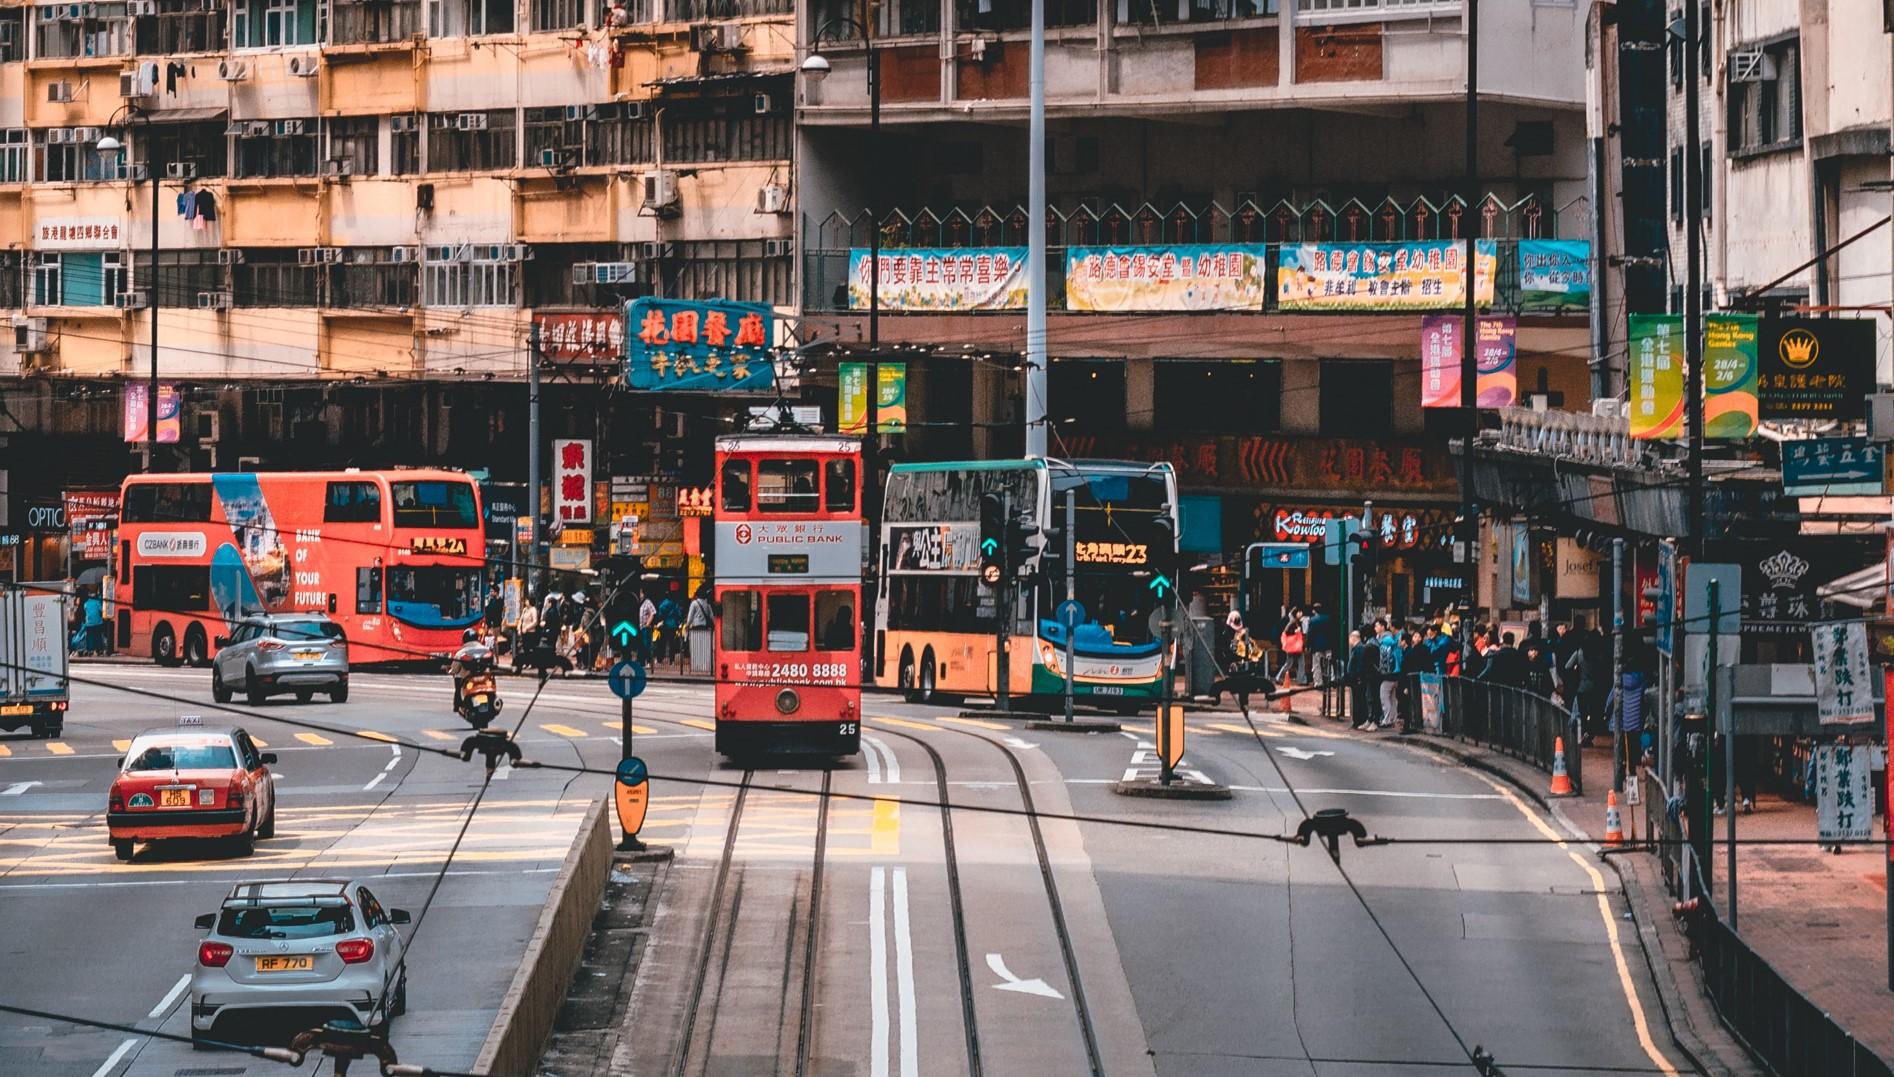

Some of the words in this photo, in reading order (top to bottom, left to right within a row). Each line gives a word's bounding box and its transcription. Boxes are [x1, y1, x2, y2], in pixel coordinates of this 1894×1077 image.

[859, 255, 1010, 284] 你們要靠主常常喜樂
[1199, 253, 1242, 279] 幼稚園
[639, 309, 766, 346] 花園餐廳
[1656, 324, 1671, 370] 第七屆
[1275, 514, 1326, 536] Kowloo
[295, 529, 321, 543] BANK
[757, 535, 804, 544] PUBLIC
[807, 535, 844, 544] BANK
[448, 537, 465, 553] 2A
[295, 548, 308, 562] OF
[1125, 544, 1148, 564] 23
[295, 571, 320, 586] YOUR
[294, 592, 327, 606] FUTURE
[1743, 625, 1783, 633] PREME
[772, 663, 808, 678] 2480
[812, 663, 848, 678] 8888
[839, 723, 856, 735] 25
[169, 789, 182, 799] HS
[261, 958, 279, 970] RF
[282, 957, 308, 970] 770
